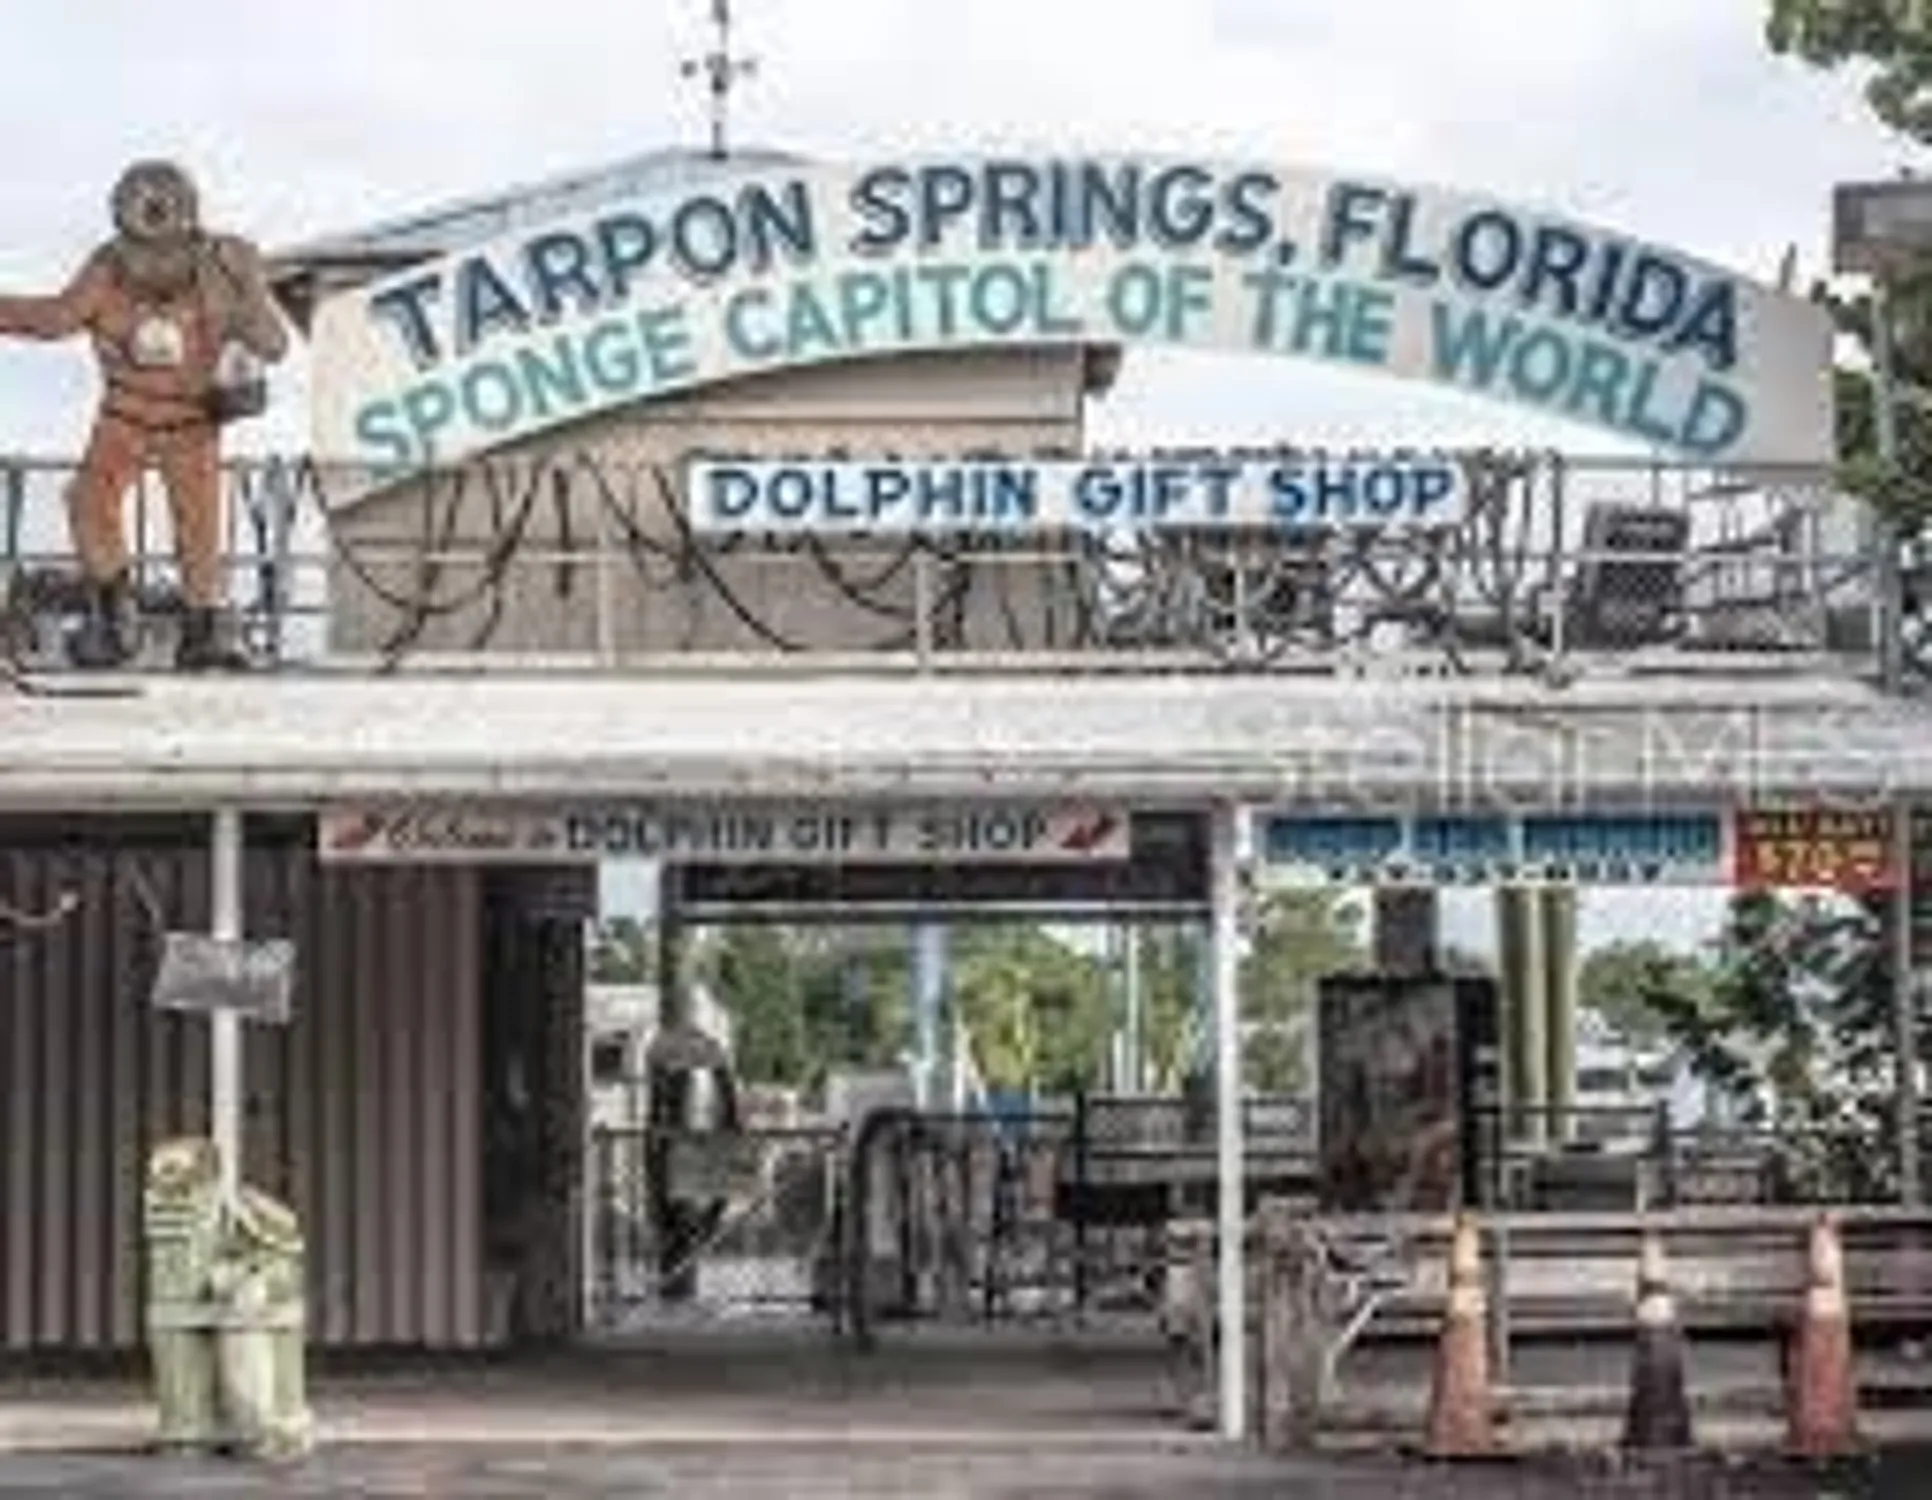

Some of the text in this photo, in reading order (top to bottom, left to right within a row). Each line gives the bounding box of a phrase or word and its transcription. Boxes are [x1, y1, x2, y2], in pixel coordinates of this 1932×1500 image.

[369, 163, 1740, 372] TARPON SPRINGS, FLORIDA
[354, 261, 1746, 479] SPONGE CAPITOL OF THE WORLD
[708, 467, 1456, 518] DOLPHIN GIFT SHOP
[565, 814, 775, 854] DOLPHIN
[792, 815, 895, 852] GIFT
[918, 815, 1047, 852] SHOP
